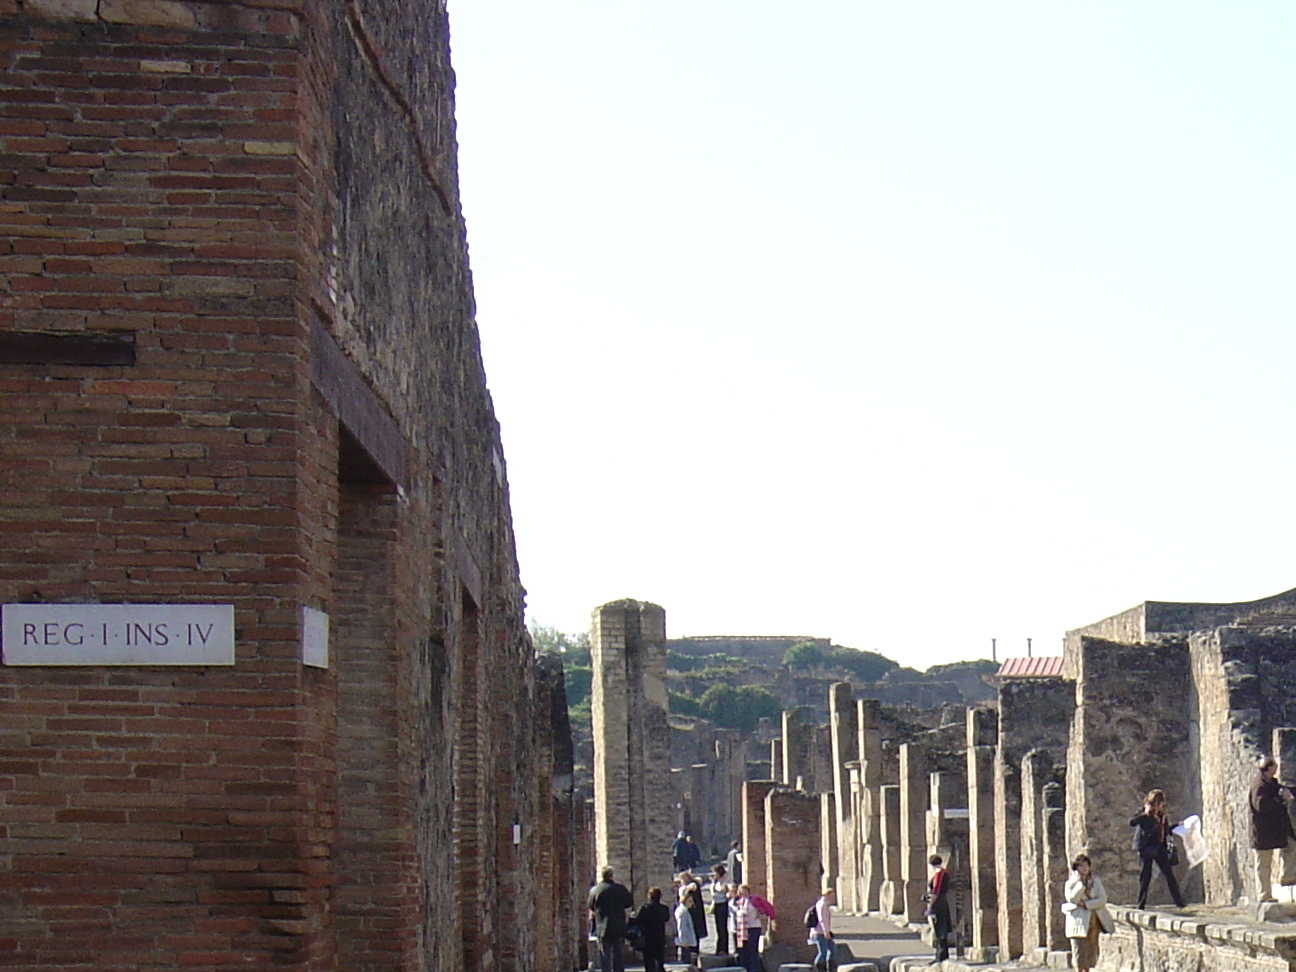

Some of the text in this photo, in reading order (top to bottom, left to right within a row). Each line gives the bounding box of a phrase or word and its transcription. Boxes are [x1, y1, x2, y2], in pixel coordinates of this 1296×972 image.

[23, 623, 84, 646] REG
[125, 623, 169, 646] INS
[187, 623, 214, 645] IV
